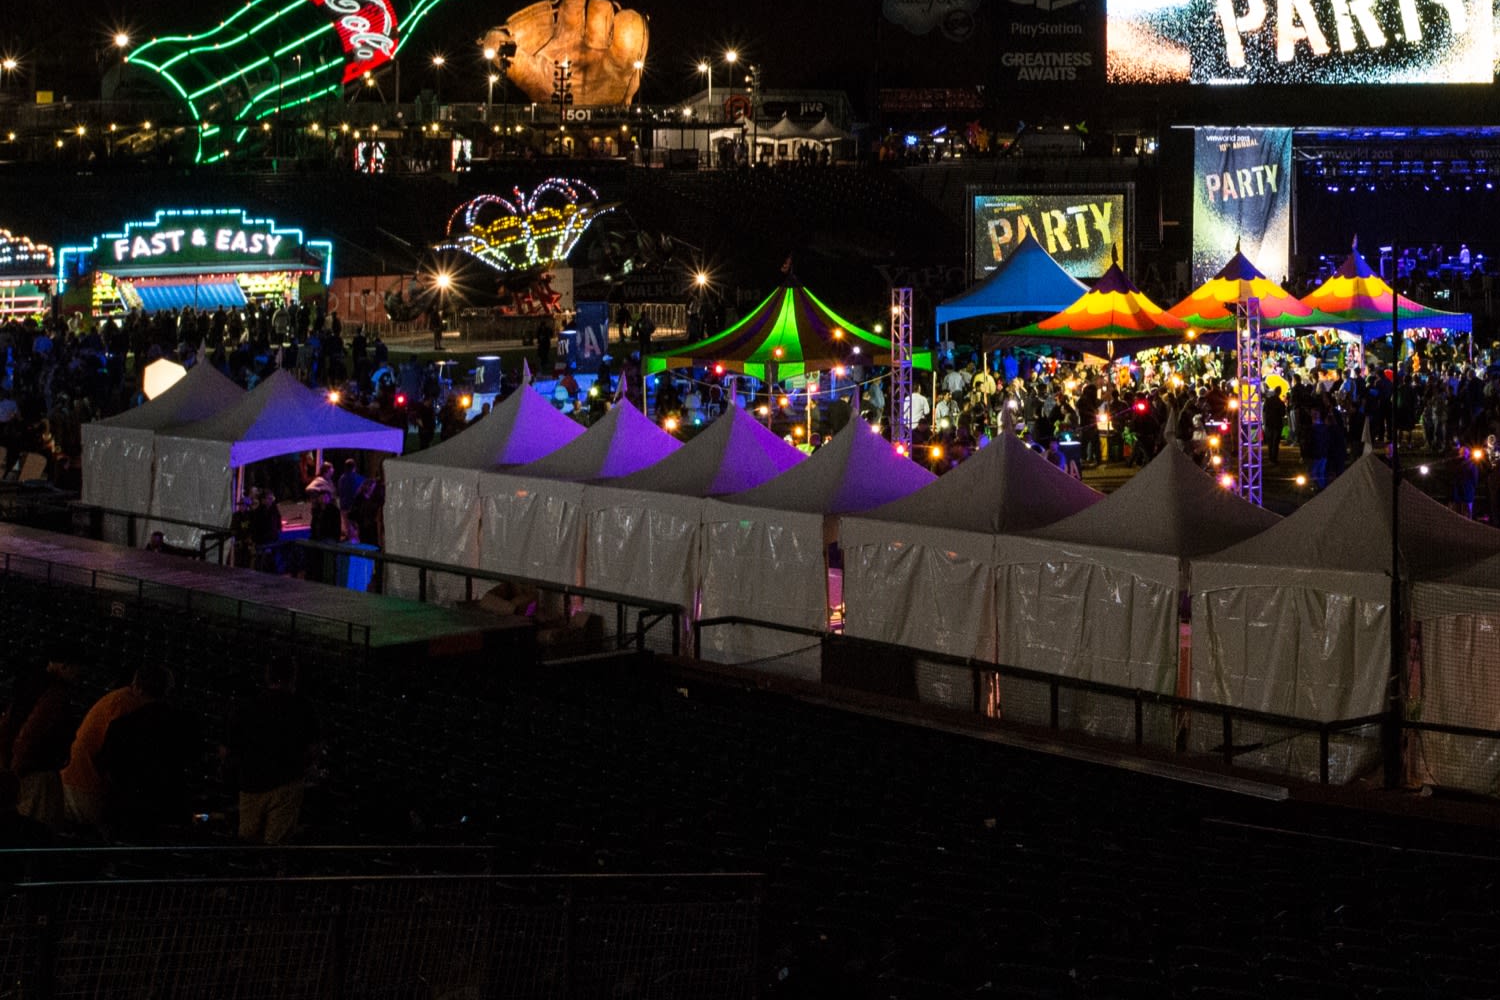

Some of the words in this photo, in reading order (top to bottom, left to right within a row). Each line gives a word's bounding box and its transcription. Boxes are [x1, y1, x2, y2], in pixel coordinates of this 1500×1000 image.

[1011, 22, 1082, 36] PlayStation
[1001, 52, 1092, 67] GREATNESS
[1017, 67, 1077, 81] AWAITS
[566, 109, 592, 121] 501
[800, 102, 824, 115] jive
[1206, 134, 1236, 142] vmworld
[1206, 164, 1278, 203] PARTY
[988, 202, 1112, 262] PARTY
[114, 229, 187, 262] FAST
[191, 228, 207, 248] &
[213, 229, 283, 256] EASY
[872, 264, 967, 287] YAHO
